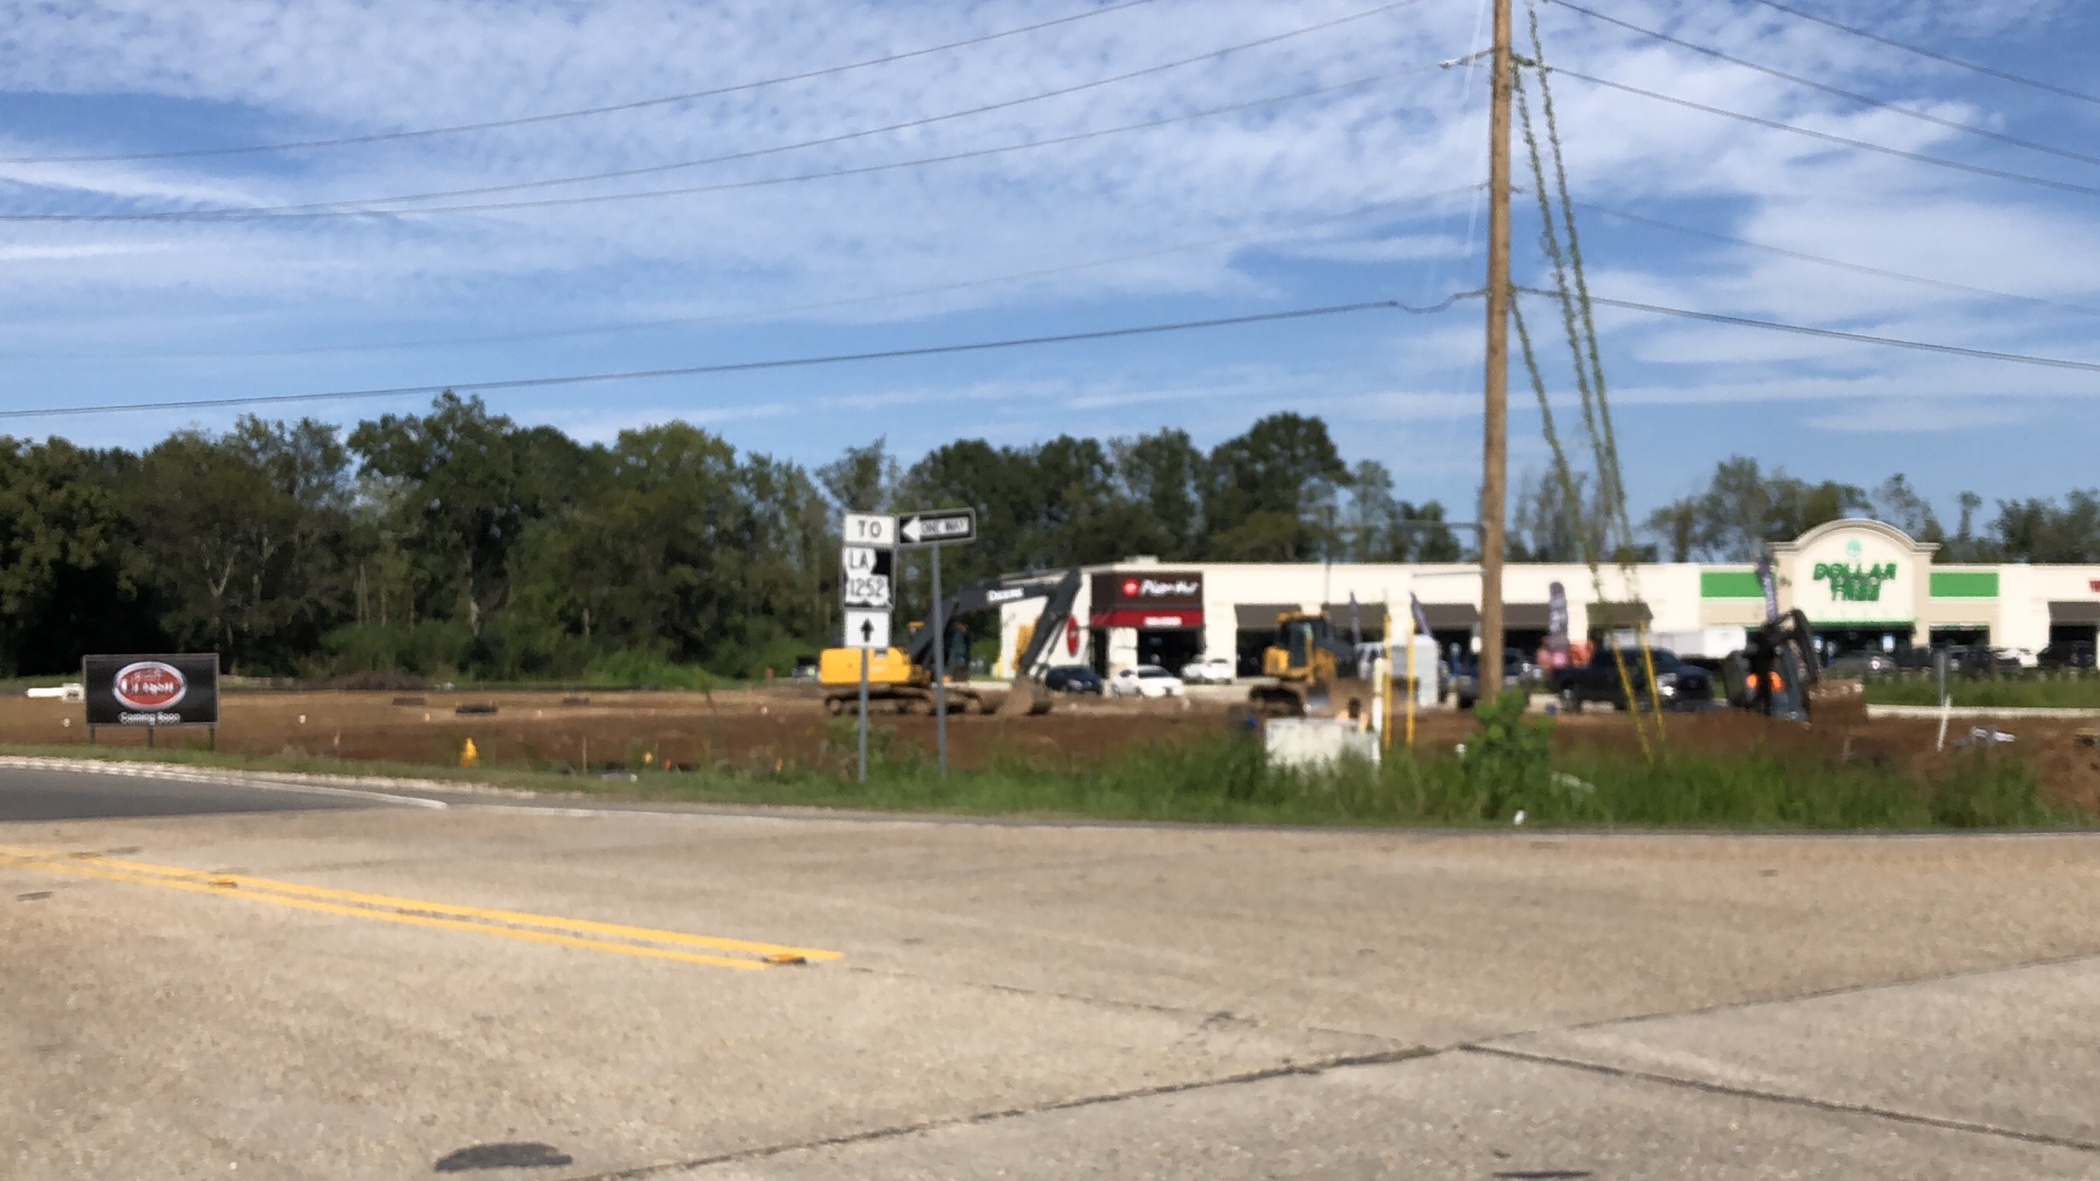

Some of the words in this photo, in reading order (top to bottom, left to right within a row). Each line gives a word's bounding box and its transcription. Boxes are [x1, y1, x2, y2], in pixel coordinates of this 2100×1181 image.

[858, 520, 882, 537] TO
[921, 521, 940, 533] ONE
[945, 518, 967, 531] WAY
[850, 552, 867, 569] LA
[1813, 563, 1897, 581] DOLLAR
[850, 578, 884, 597] 1252
[119, 711, 156, 725] Coming
[157, 711, 181, 724] Soon
